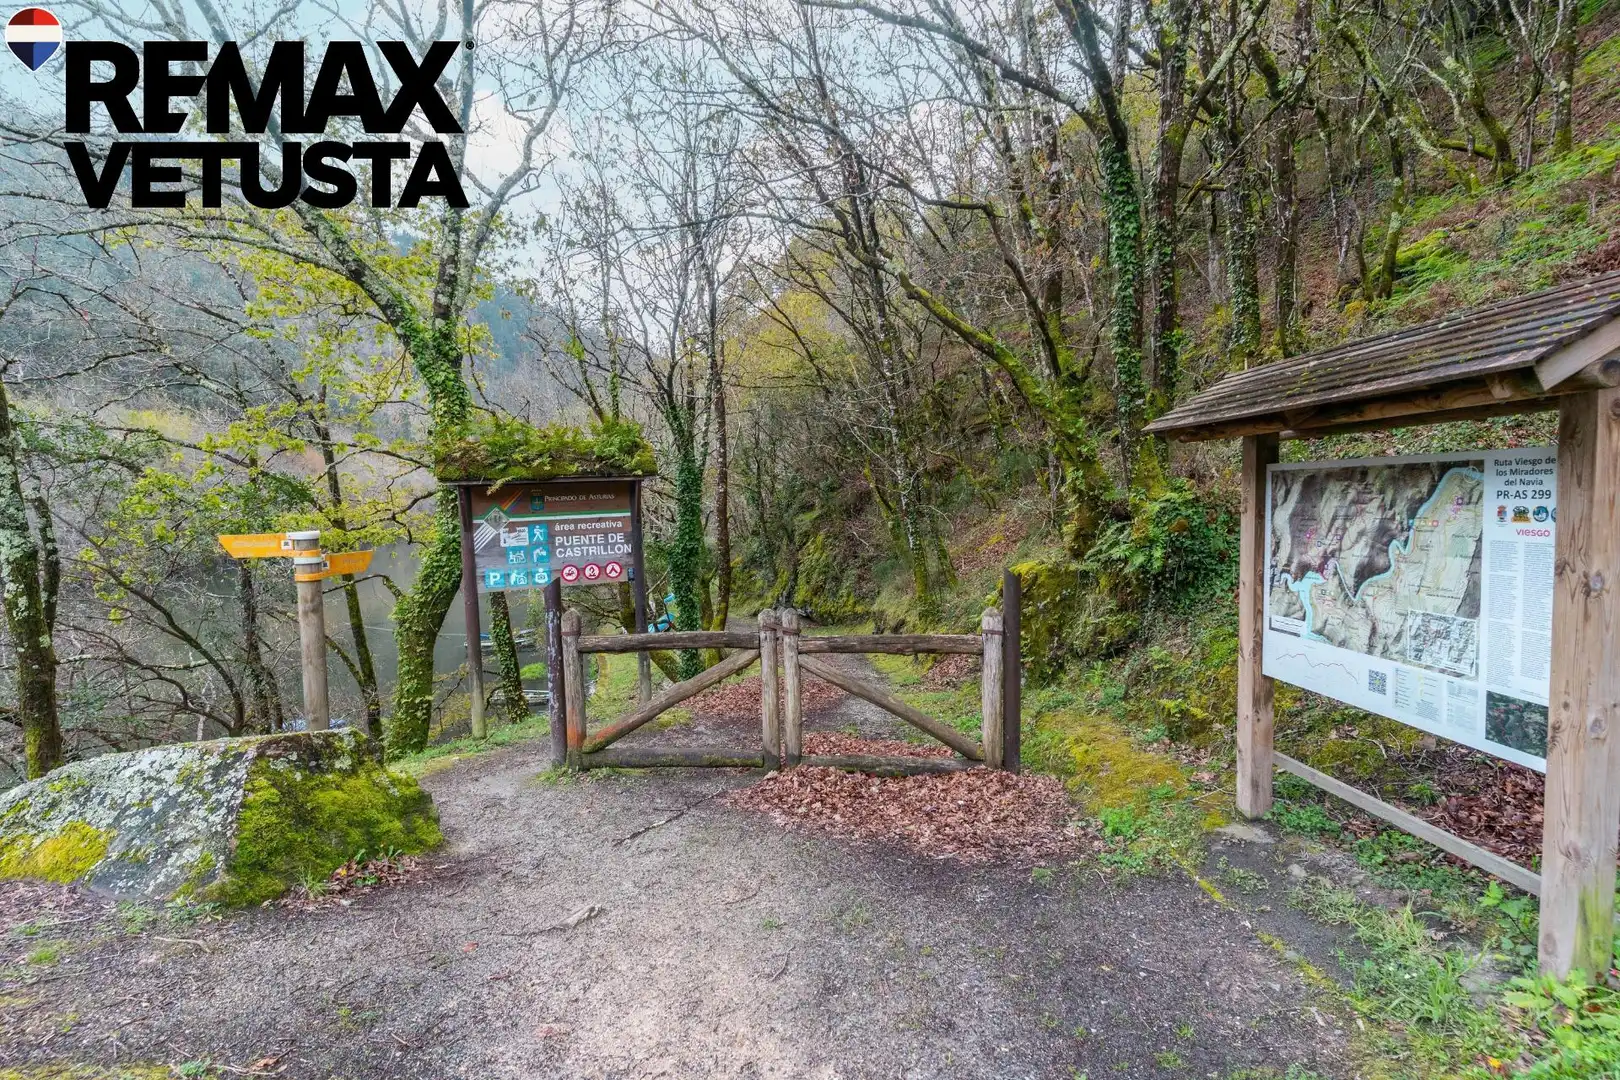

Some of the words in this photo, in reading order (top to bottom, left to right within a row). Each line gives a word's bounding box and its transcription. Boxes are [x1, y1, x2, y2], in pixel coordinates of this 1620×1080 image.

[1494, 459, 1512, 467] Ruta
[1514, 457, 1543, 467] Viesgo
[1545, 456, 1556, 465] de
[1496, 468, 1507, 476] los
[1509, 467, 1553, 476] Miradores
[1504, 478, 1517, 486] del
[1519, 477, 1543, 486] Navia
[1496, 490, 1528, 500] PR-AS
[1531, 489, 1551, 499] 299
[554, 522, 575, 531] área
[577, 520, 622, 530] recreativa
[555, 533, 604, 546] PUENTE
[608, 532, 624, 543] DE
[555, 543, 632, 558] CASTRILLON
